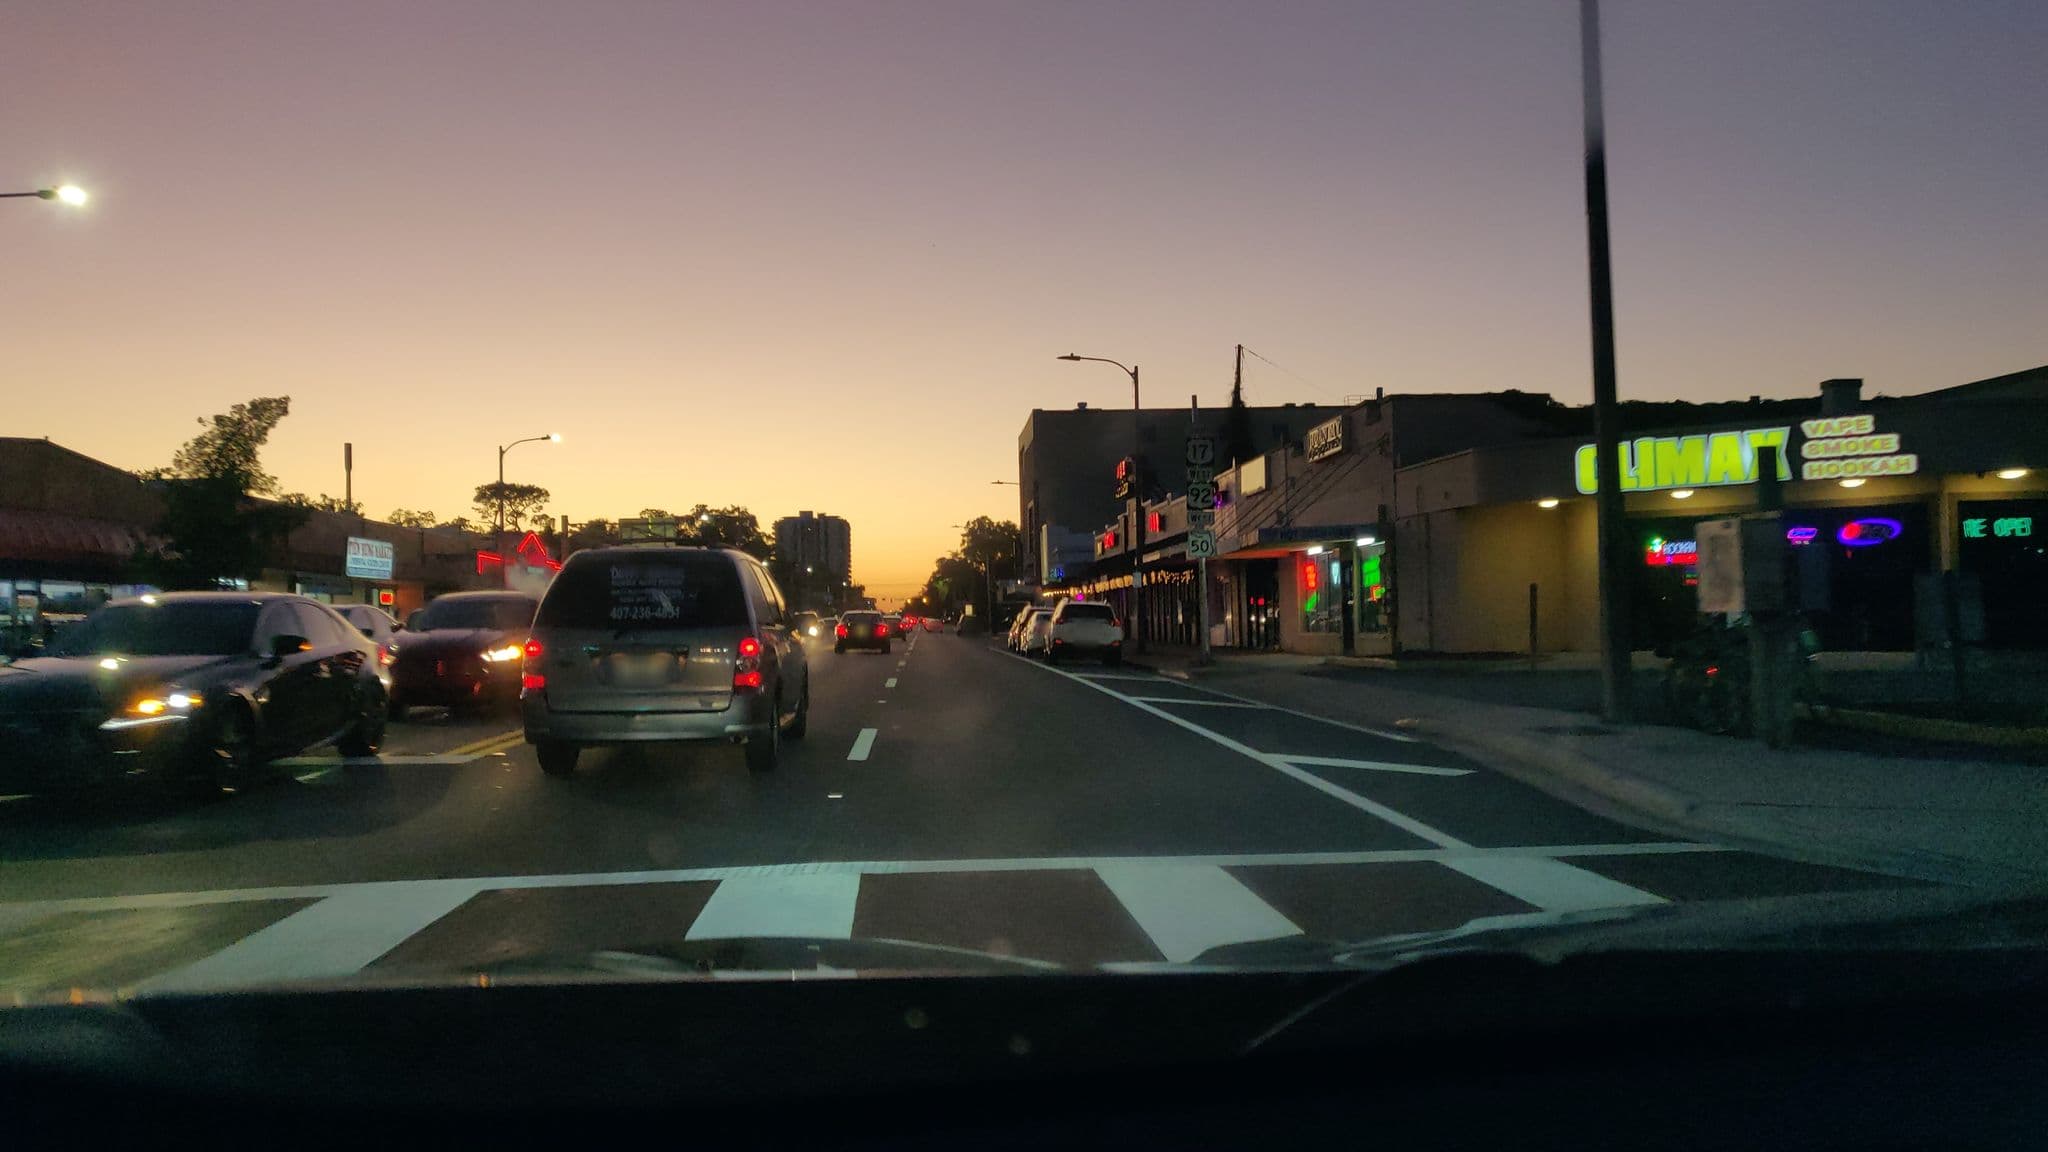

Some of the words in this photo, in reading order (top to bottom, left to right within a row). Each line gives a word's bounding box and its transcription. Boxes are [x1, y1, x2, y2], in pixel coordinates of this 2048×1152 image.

[1803, 416, 1872, 437] VAPE
[1191, 444, 1209, 458] 17
[1803, 436, 1897, 457] SMOKE
[1804, 456, 1916, 478] HOOKAH
[1190, 487, 1211, 503] 92
[1191, 541, 1209, 553] 50
